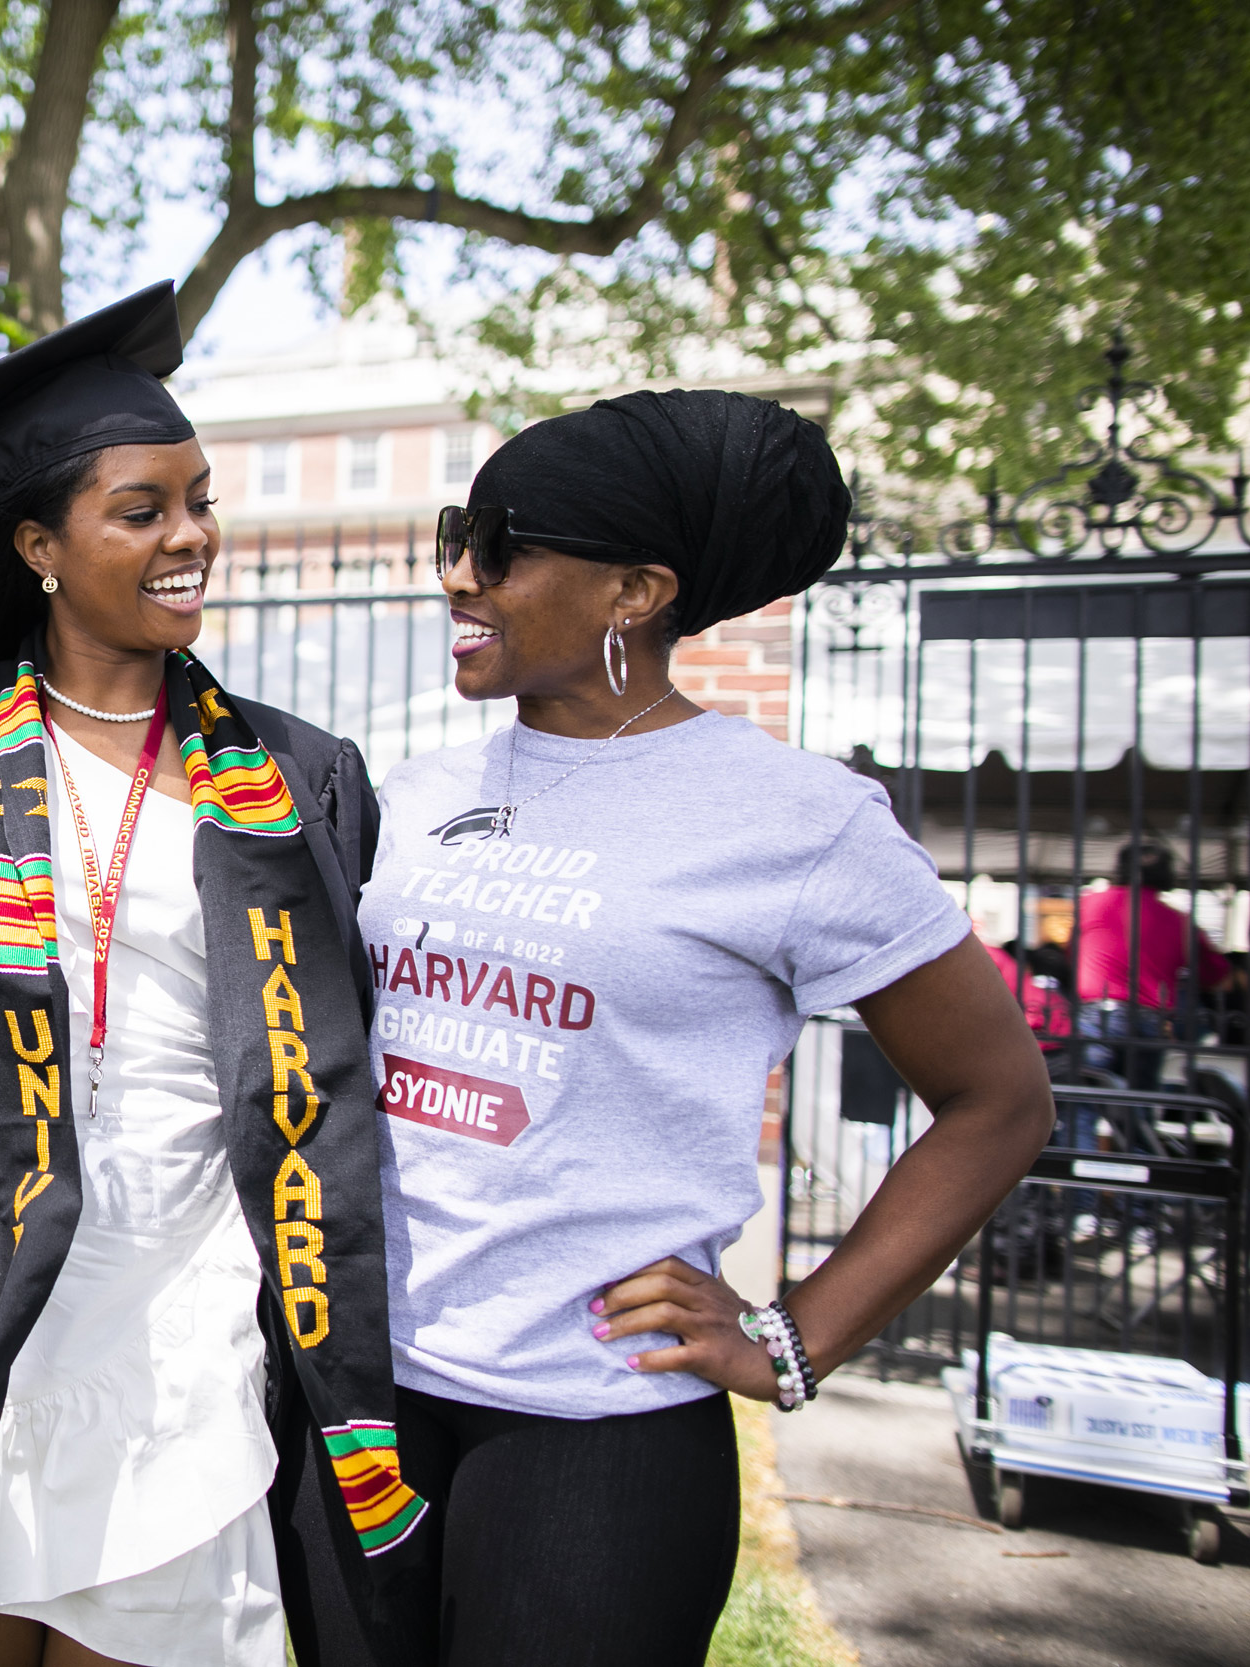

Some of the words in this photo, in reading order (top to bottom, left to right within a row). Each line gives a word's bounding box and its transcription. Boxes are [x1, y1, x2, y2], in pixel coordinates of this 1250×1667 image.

[103, 767, 149, 905] COMMENCEMENT
[446, 836, 599, 880] PROUD
[400, 866, 603, 930] TEACHER
[96, 917, 111, 963] 2022
[462, 929, 488, 950] OF
[496, 937, 507, 955] A
[512, 939, 566, 967] 2022
[369, 943, 596, 1031] HARVARD
[377, 1005, 565, 1082] GRADUATE
[4, 1008, 60, 1256] UNIV
[247, 907, 330, 1350] HARVARD
[386, 1070, 504, 1132] SYDNIE
